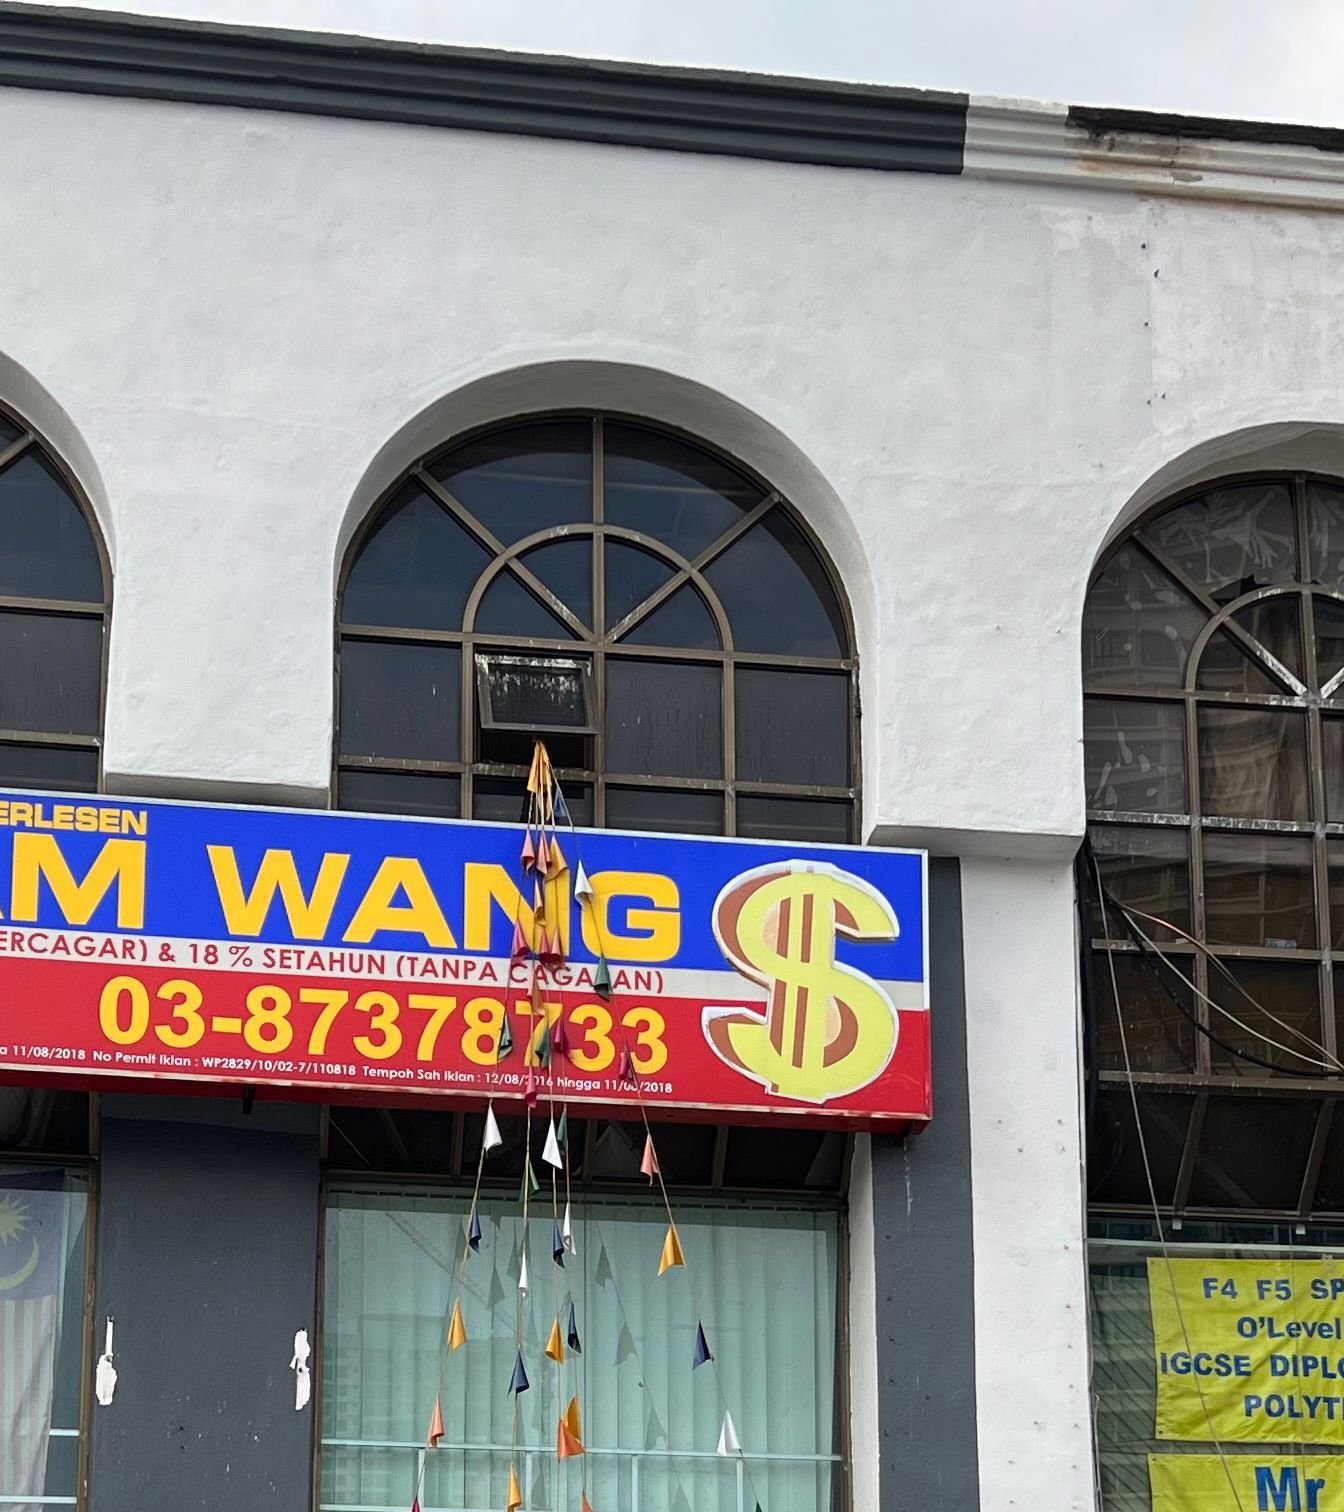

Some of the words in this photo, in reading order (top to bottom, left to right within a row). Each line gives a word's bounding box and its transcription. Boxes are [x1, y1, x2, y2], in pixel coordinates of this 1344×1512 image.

[206, 844, 681, 961] WANG
[158, 942, 176, 962] &
[189, 943, 219, 965] 18
[262, 947, 385, 976] SETAHUN
[396, 954, 498, 983] (TANPA
[99, 975, 668, 1075] 03-87378733
[12, 1044, 86, 1061] 11/08/2018
[93, 1051, 112, 1063] No
[115, 1052, 156, 1065] Permit
[362, 1065, 414, 1081] Tempoh
[417, 1068, 440, 1080] Sah
[557, 1077, 601, 1092] hingga
[1203, 1278, 1238, 1300] F4
[1257, 1279, 1292, 1300] F5
[1237, 1317, 1342, 1339] O'Level
[1160, 1353, 1252, 1376] IGCSE
[1255, 1466, 1324, 1512] Mr
